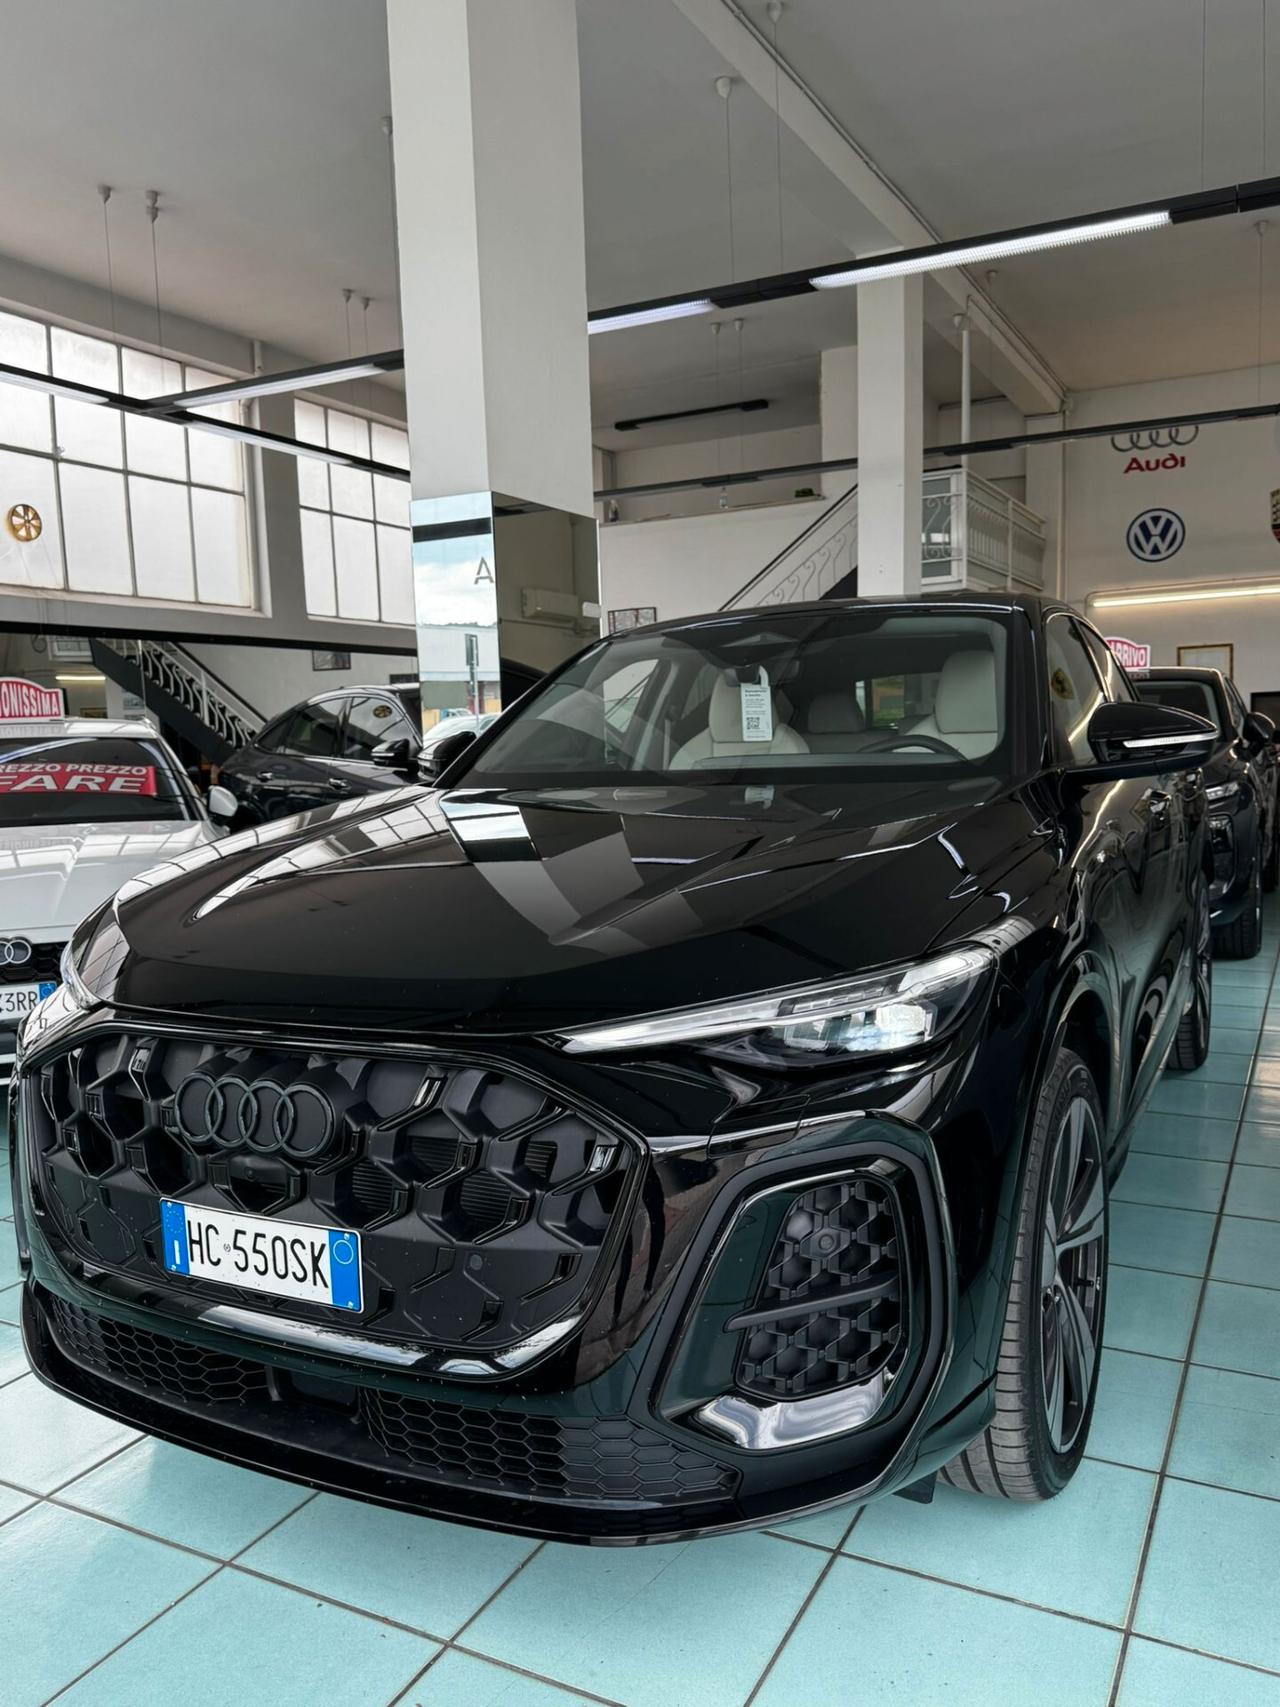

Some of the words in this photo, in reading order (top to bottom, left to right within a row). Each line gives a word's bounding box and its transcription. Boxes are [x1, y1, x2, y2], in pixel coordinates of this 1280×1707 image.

[1123, 453, 1186, 474] Audi
[0, 682, 60, 718] ONISSIMA
[65, 763, 147, 775] PREZZO
[0, 991, 38, 1012] 3RR
[187, 1220, 222, 1267] HC
[232, 1229, 329, 1289] 550SK
